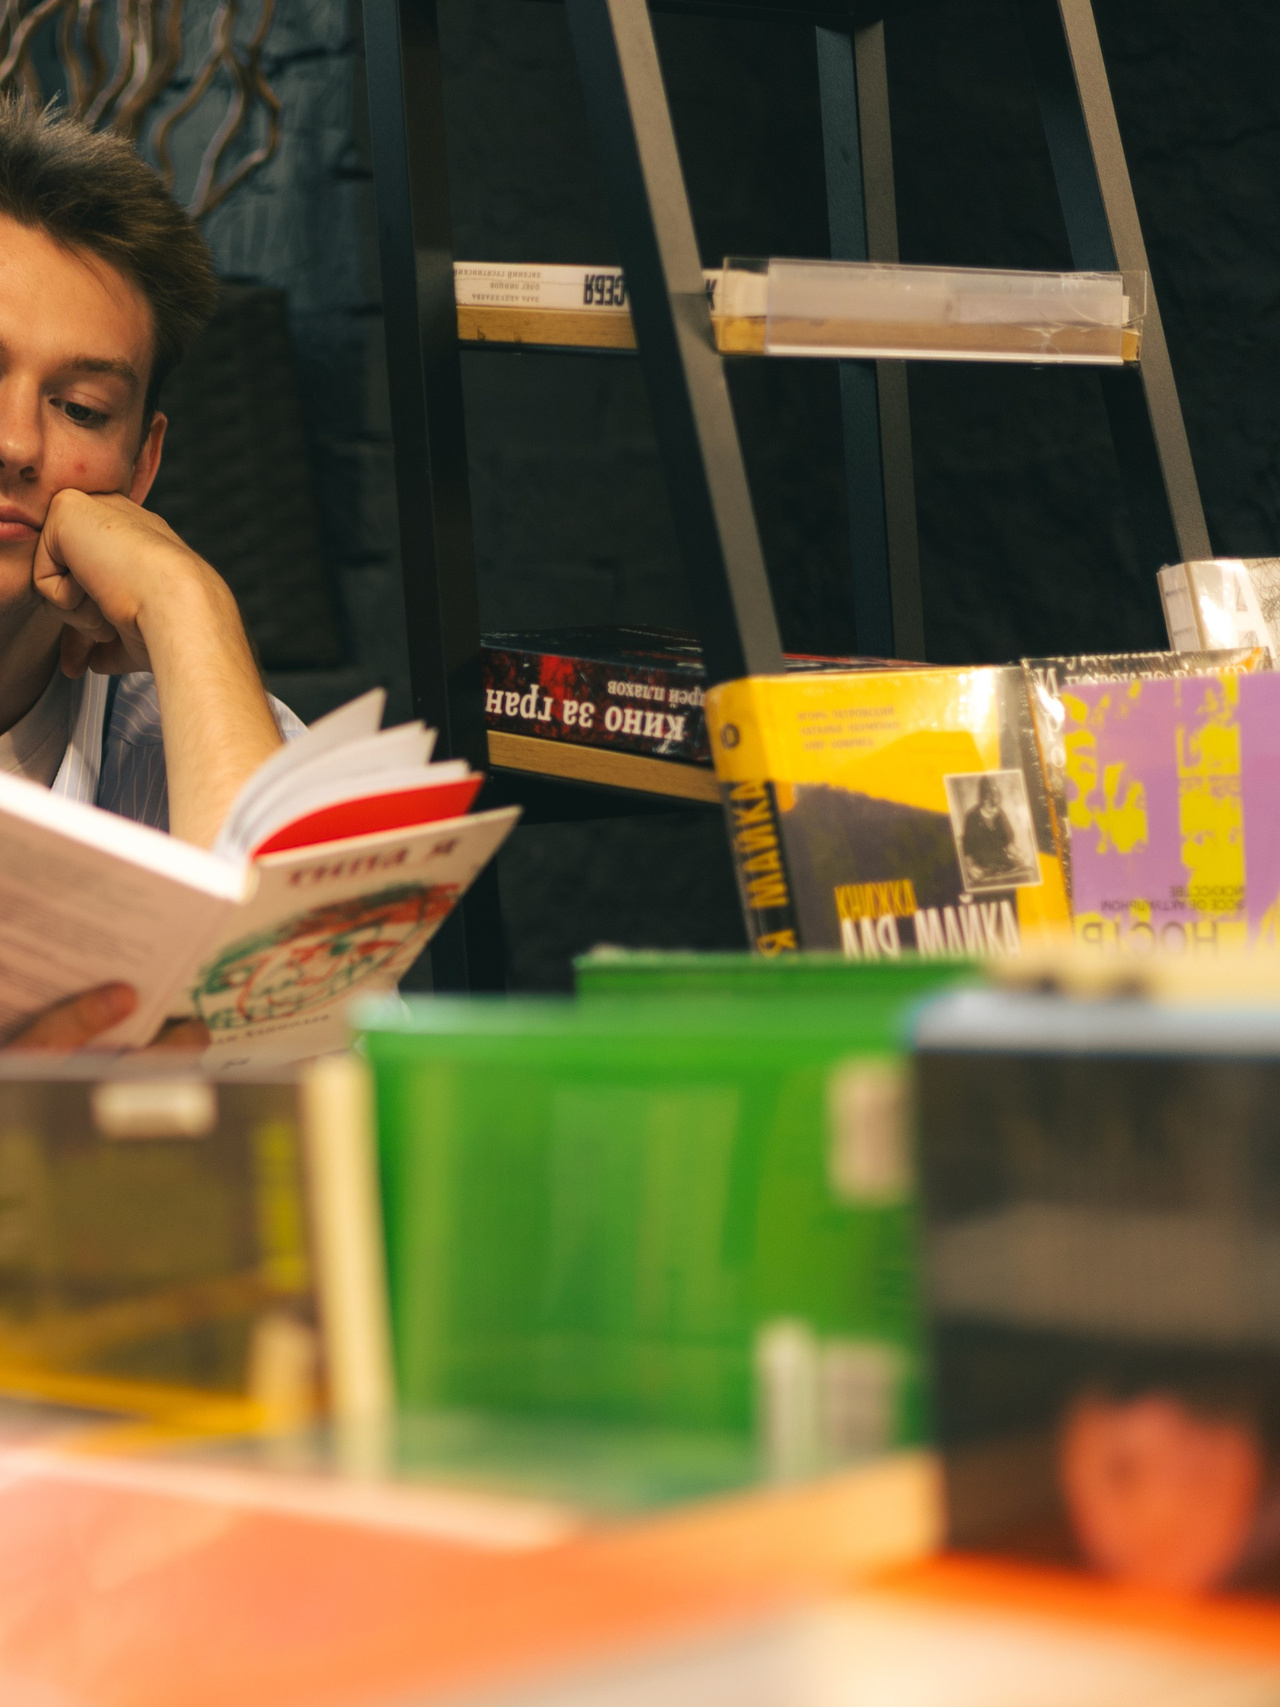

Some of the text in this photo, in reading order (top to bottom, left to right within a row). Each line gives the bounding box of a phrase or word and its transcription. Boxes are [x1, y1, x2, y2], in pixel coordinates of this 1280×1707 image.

[607, 680, 666, 703] плахов
[562, 699, 595, 728] за
[604, 705, 686, 741] кино
[833, 877, 916, 921] КНИЖКА
